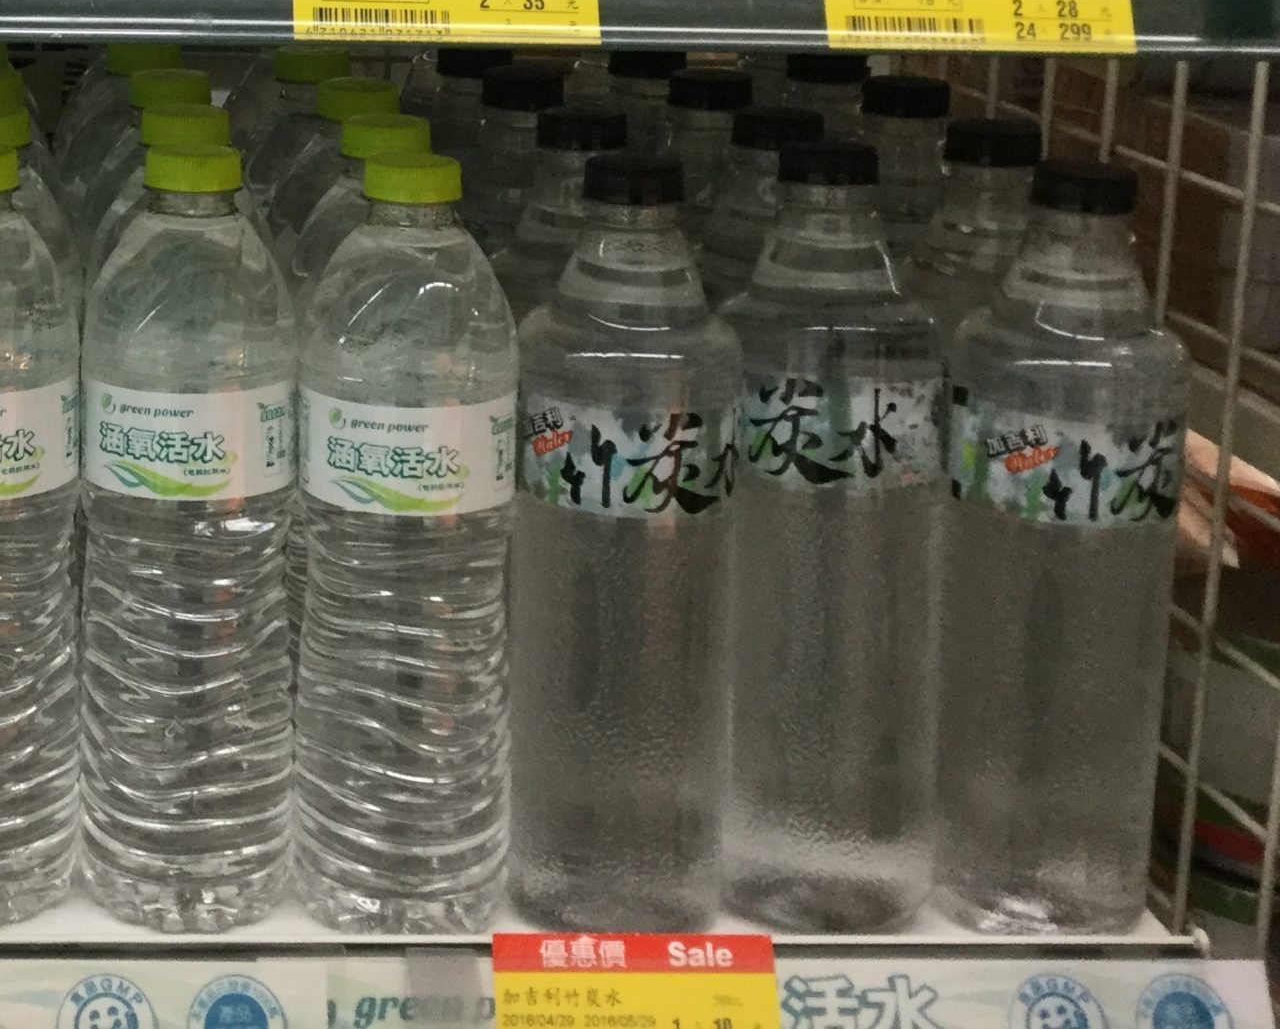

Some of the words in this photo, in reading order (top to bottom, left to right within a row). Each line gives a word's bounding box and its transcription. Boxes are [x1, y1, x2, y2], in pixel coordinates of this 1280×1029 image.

[1012, 0, 1023, 17] 2
[1056, 0, 1079, 18] 28
[1015, 22, 1036, 40] 24
[1060, 23, 1092, 41] 299
[120, 403, 151, 415] green
[153, 407, 194, 418] power
[350, 418, 385, 431] green
[387, 422, 429, 434] power
[524, 406, 564, 439] 吉利
[99, 421, 226, 464] 涵氧活水
[327, 436, 461, 479] 涵氧活水
[540, 939, 626, 968] 優惠價
[668, 941, 733, 968] Sale
[503, 987, 622, 1008] 加吉利竹炭水
